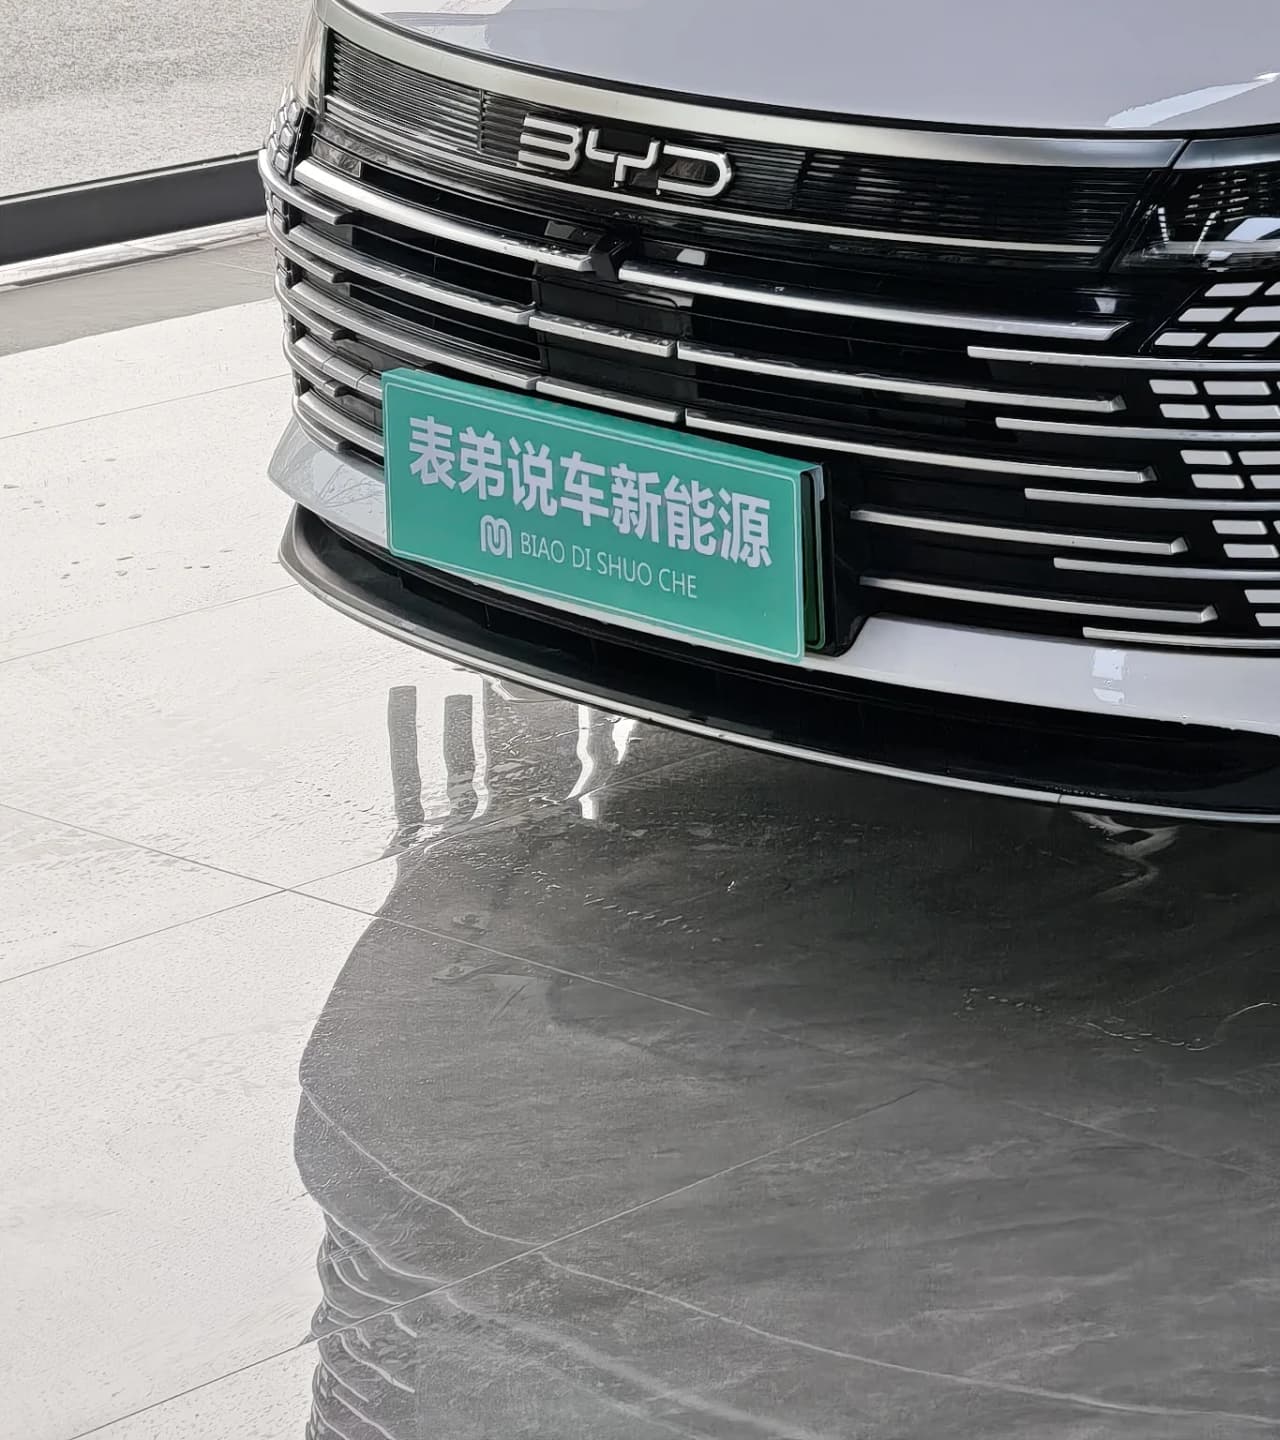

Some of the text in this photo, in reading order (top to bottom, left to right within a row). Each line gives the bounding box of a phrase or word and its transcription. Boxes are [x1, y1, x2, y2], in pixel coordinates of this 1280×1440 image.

[517, 113, 733, 198] BYD
[408, 415, 773, 569] 表弟说车新能源
[520, 532, 698, 599] BIAO DI SHUO CHE
